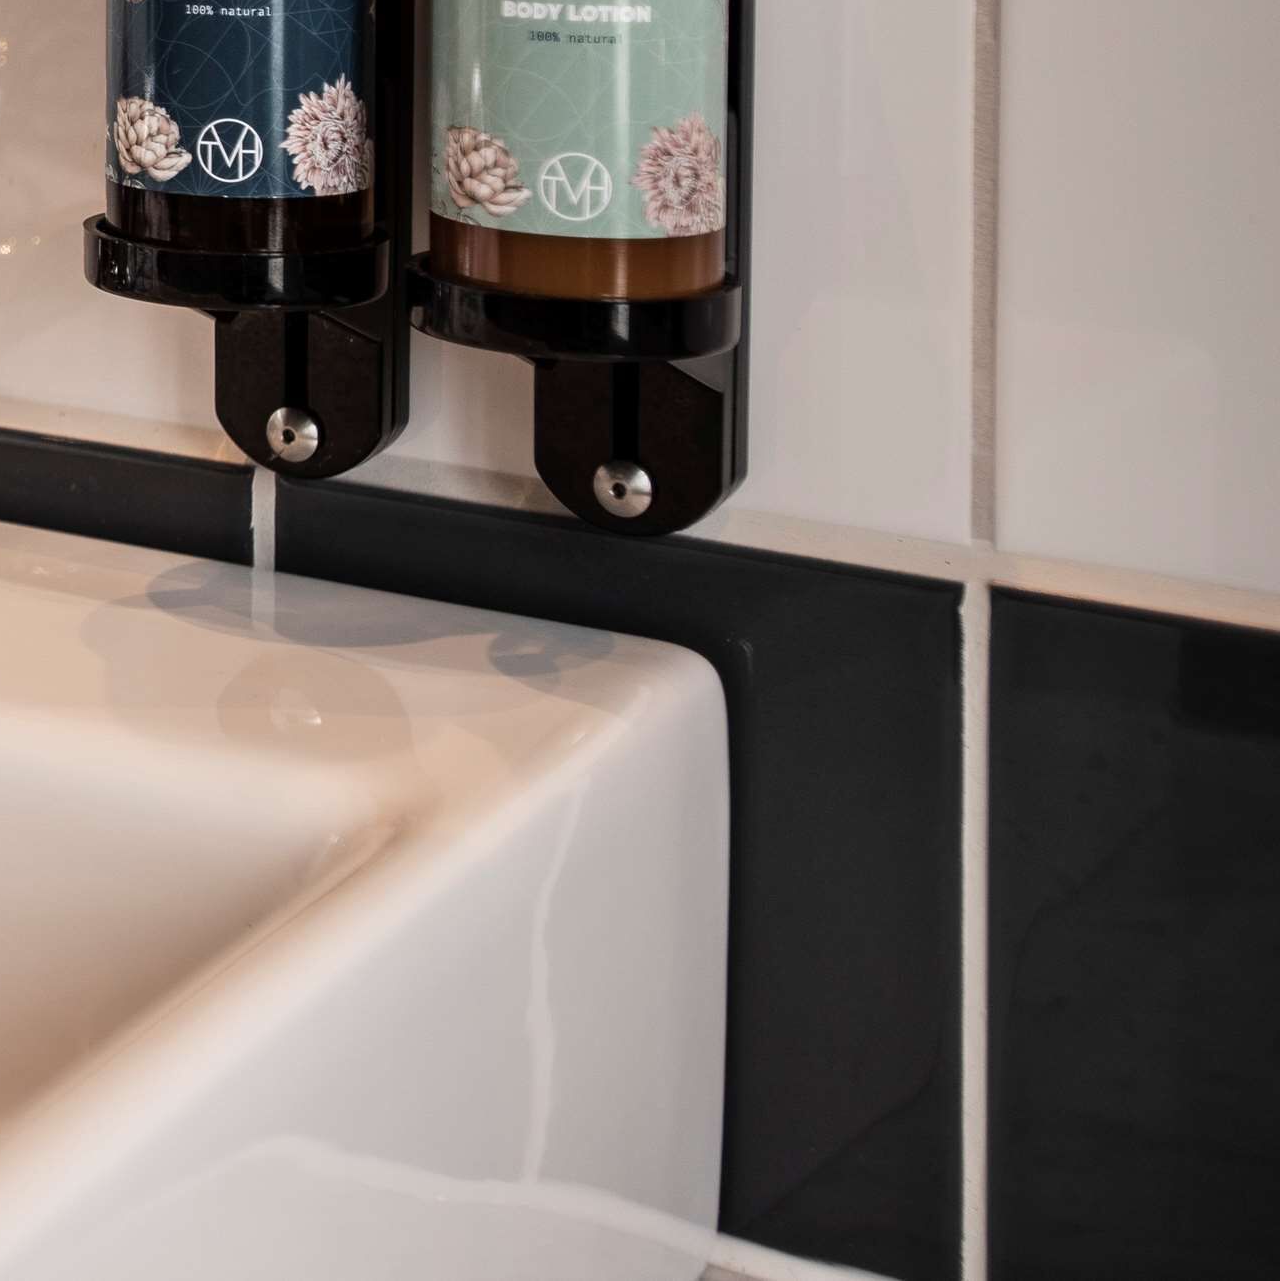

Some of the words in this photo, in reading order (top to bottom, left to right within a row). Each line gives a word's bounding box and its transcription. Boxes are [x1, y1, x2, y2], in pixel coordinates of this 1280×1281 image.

[185, 4, 214, 16] 100%
[221, 6, 272, 17] natural
[501, 0, 564, 20] BODY
[566, 4, 652, 23] LOTION
[528, 30, 561, 43] 100%
